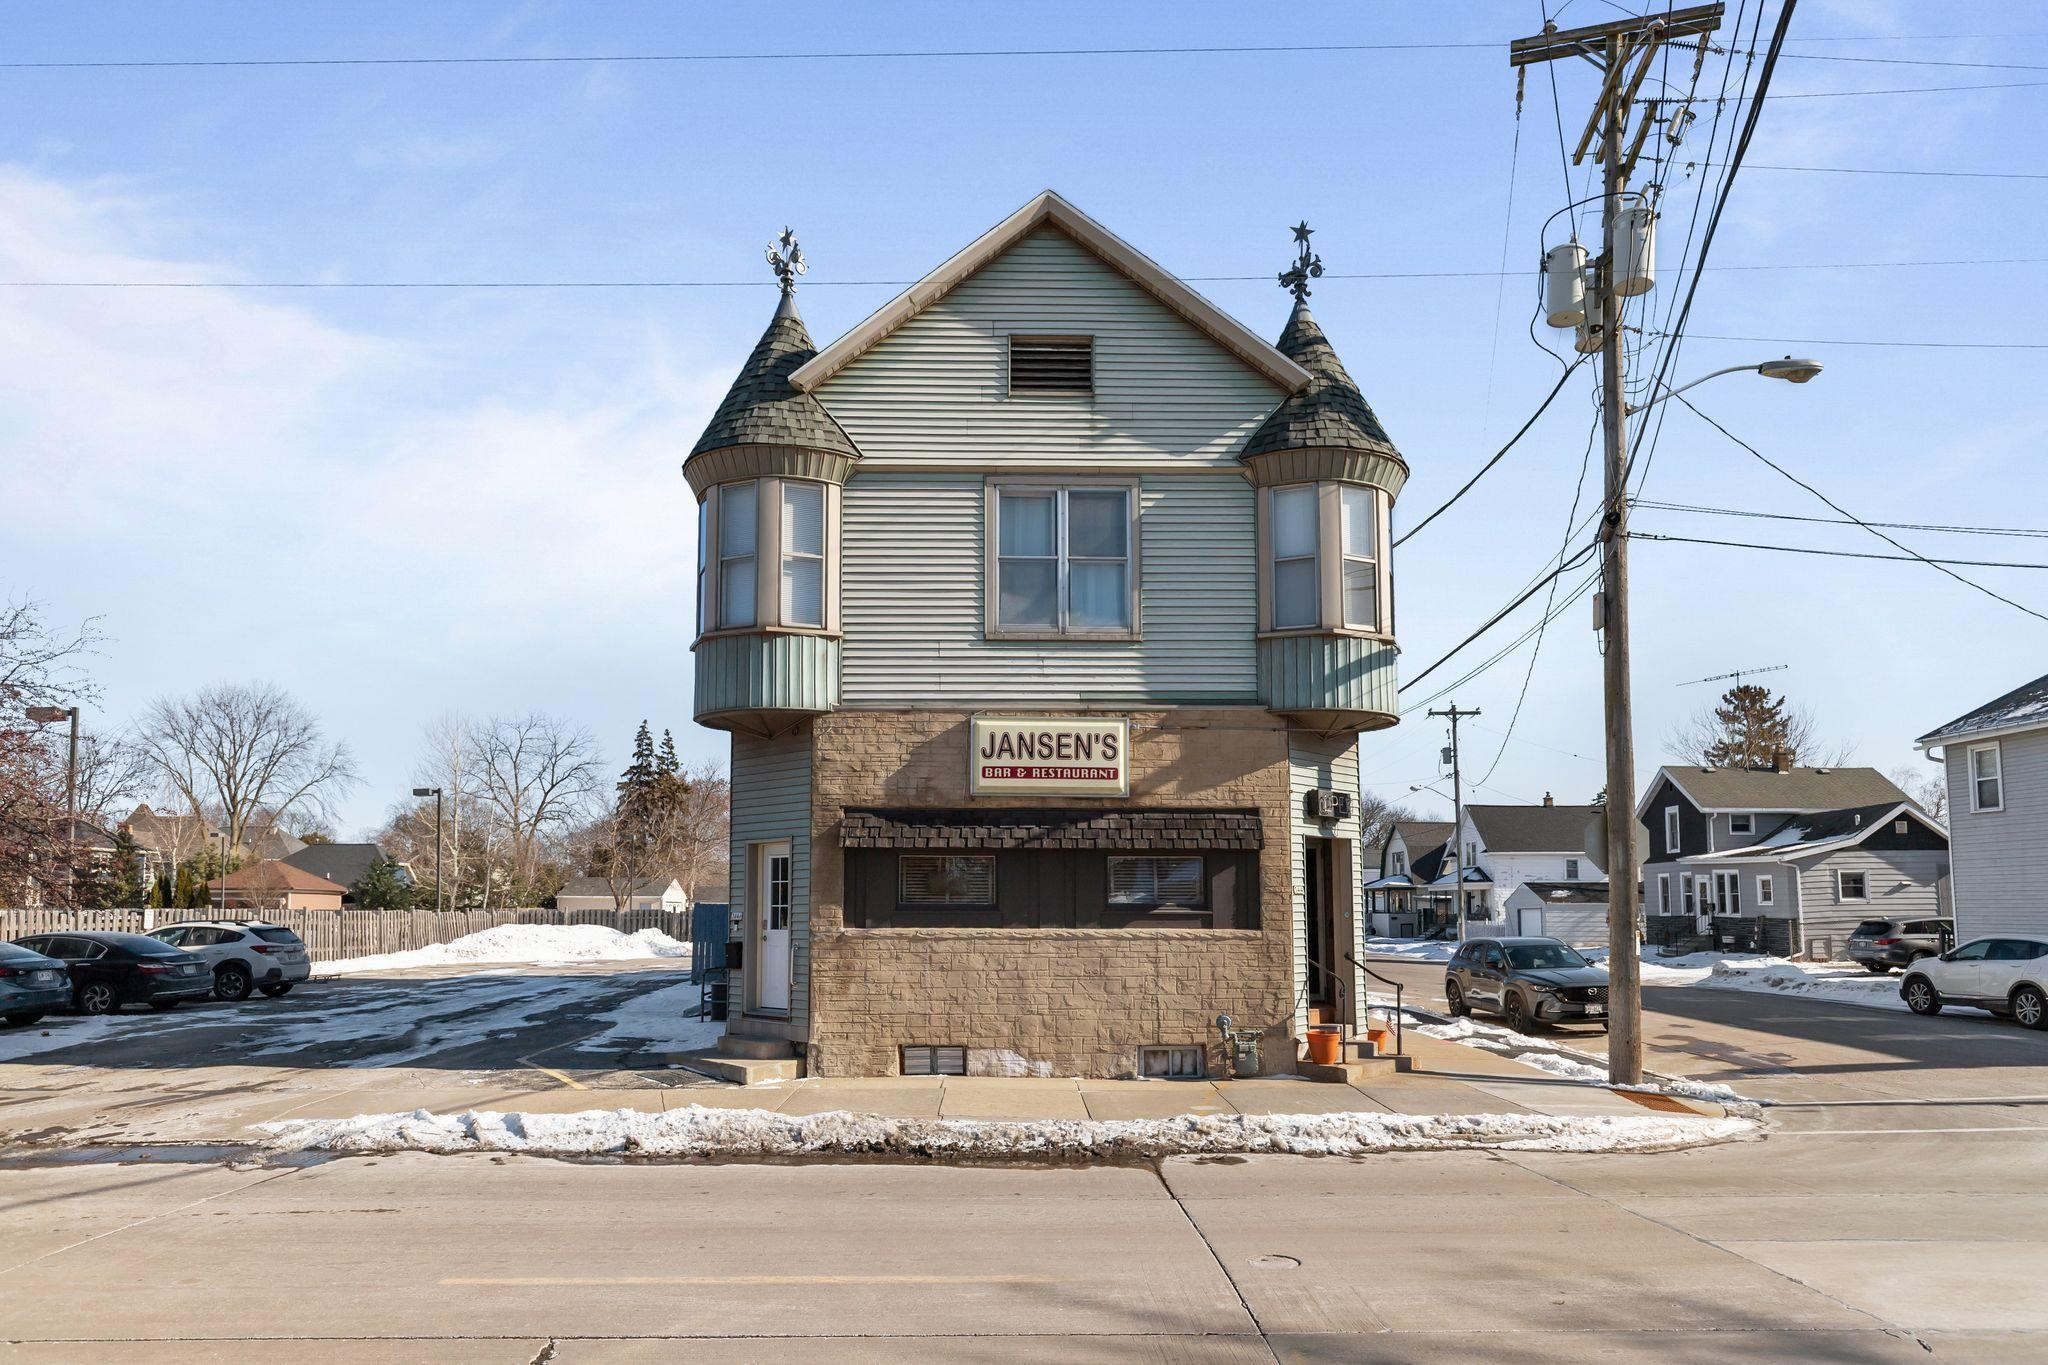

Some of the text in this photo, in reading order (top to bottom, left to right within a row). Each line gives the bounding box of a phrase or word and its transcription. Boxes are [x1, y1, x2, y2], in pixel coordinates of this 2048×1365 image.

[980, 731, 1119, 761] JANSEN'S
[985, 767, 1116, 779] BAR & RESTAURANT
